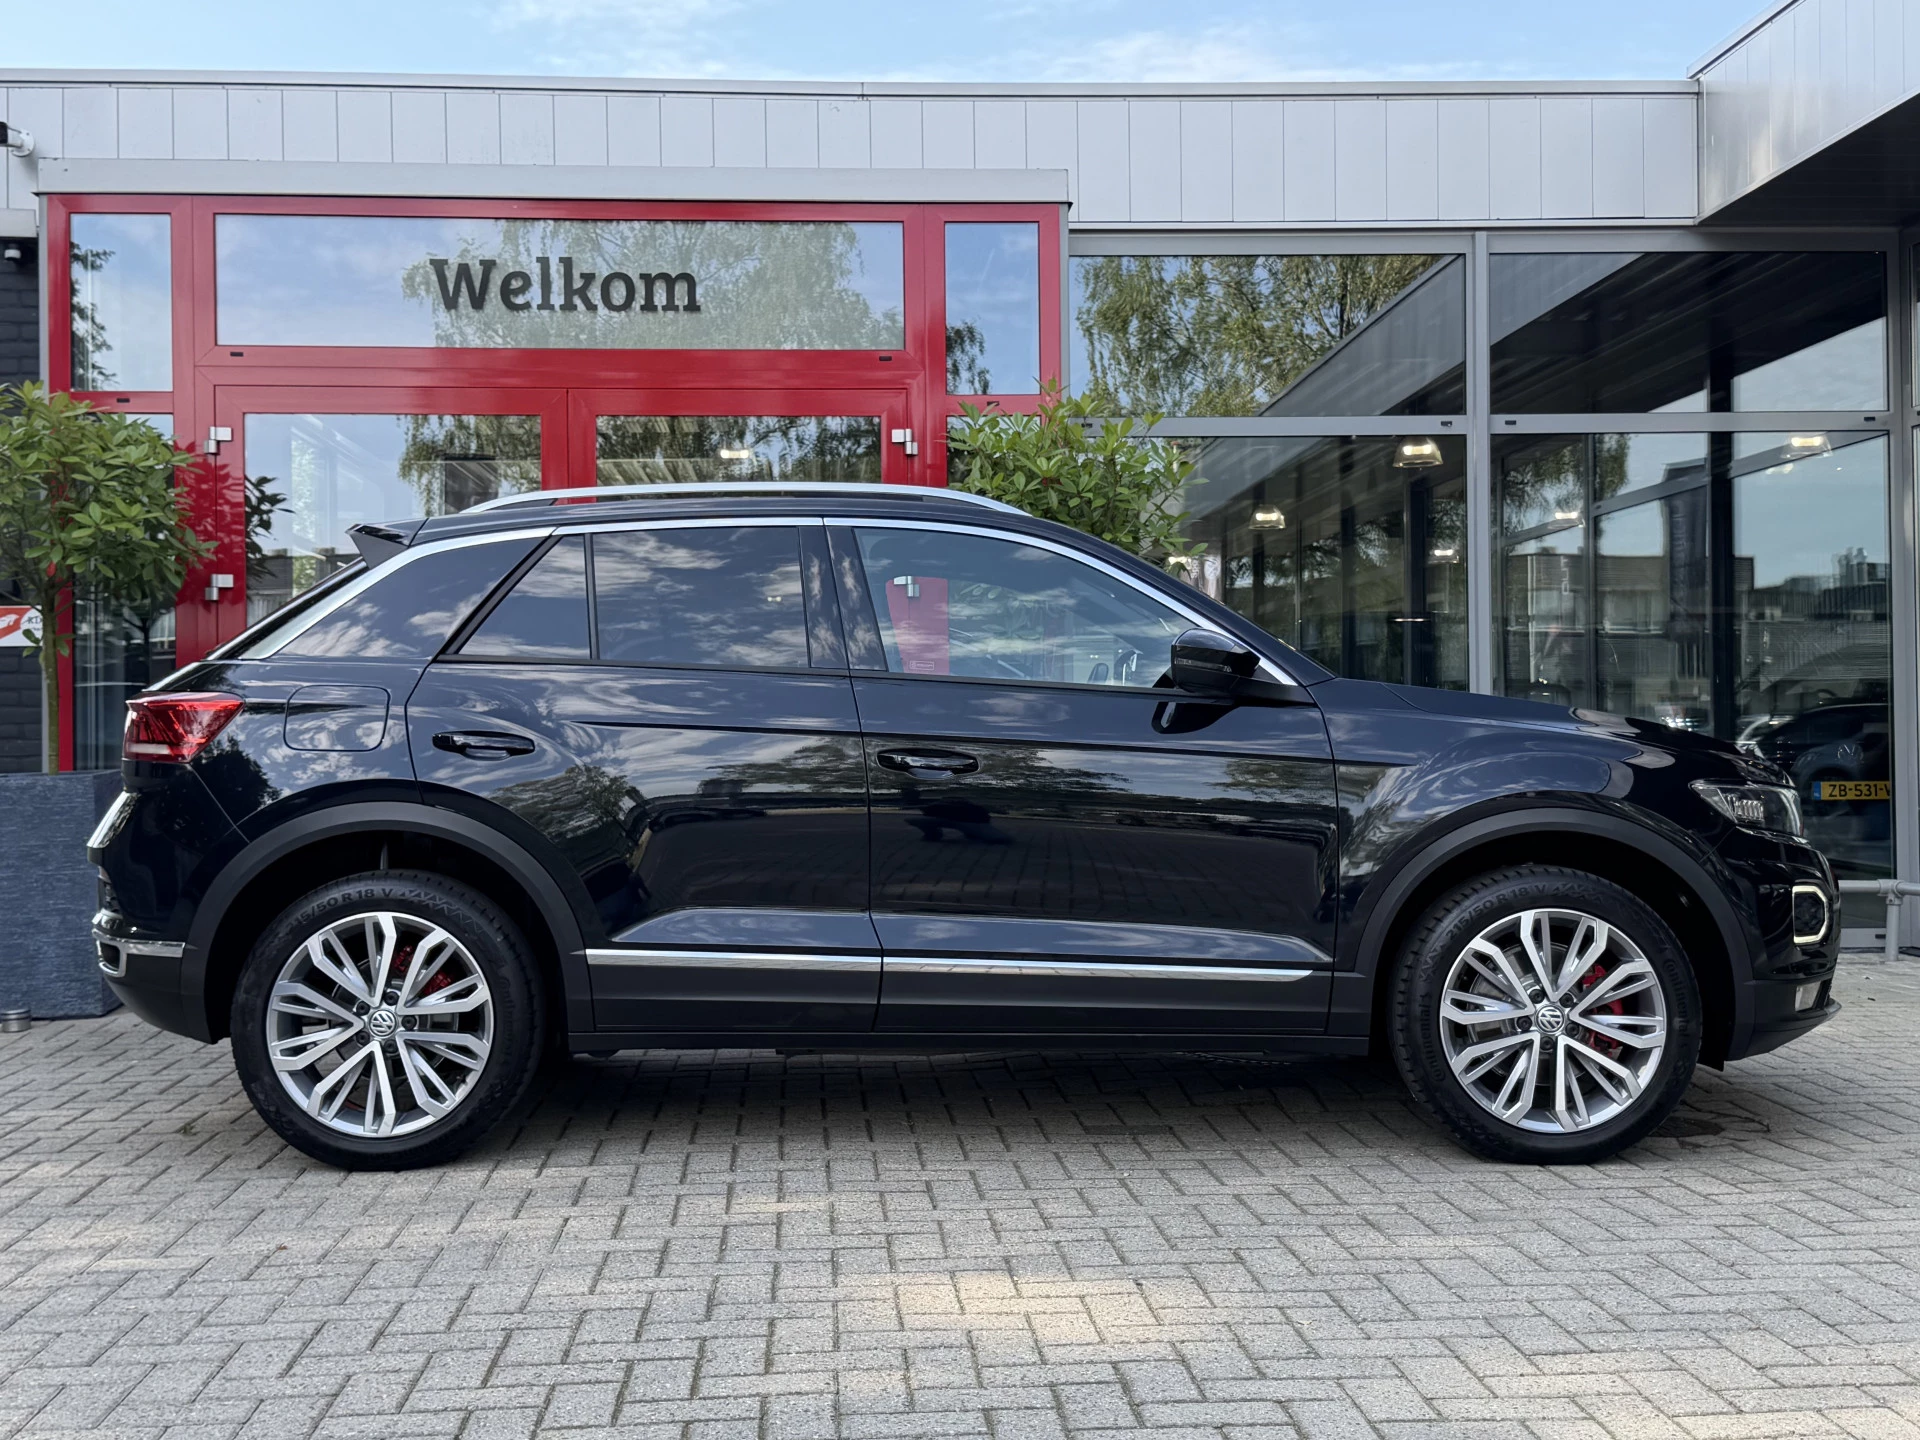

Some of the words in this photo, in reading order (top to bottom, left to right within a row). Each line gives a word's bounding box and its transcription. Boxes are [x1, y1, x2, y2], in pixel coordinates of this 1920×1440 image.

[429, 256, 701, 312] Welkom
[341, 892, 353, 903] R
[355, 888, 375, 899] 18
[381, 888, 394, 898] V
[1496, 893, 1509, 905] R
[1510, 887, 1529, 898] 18
